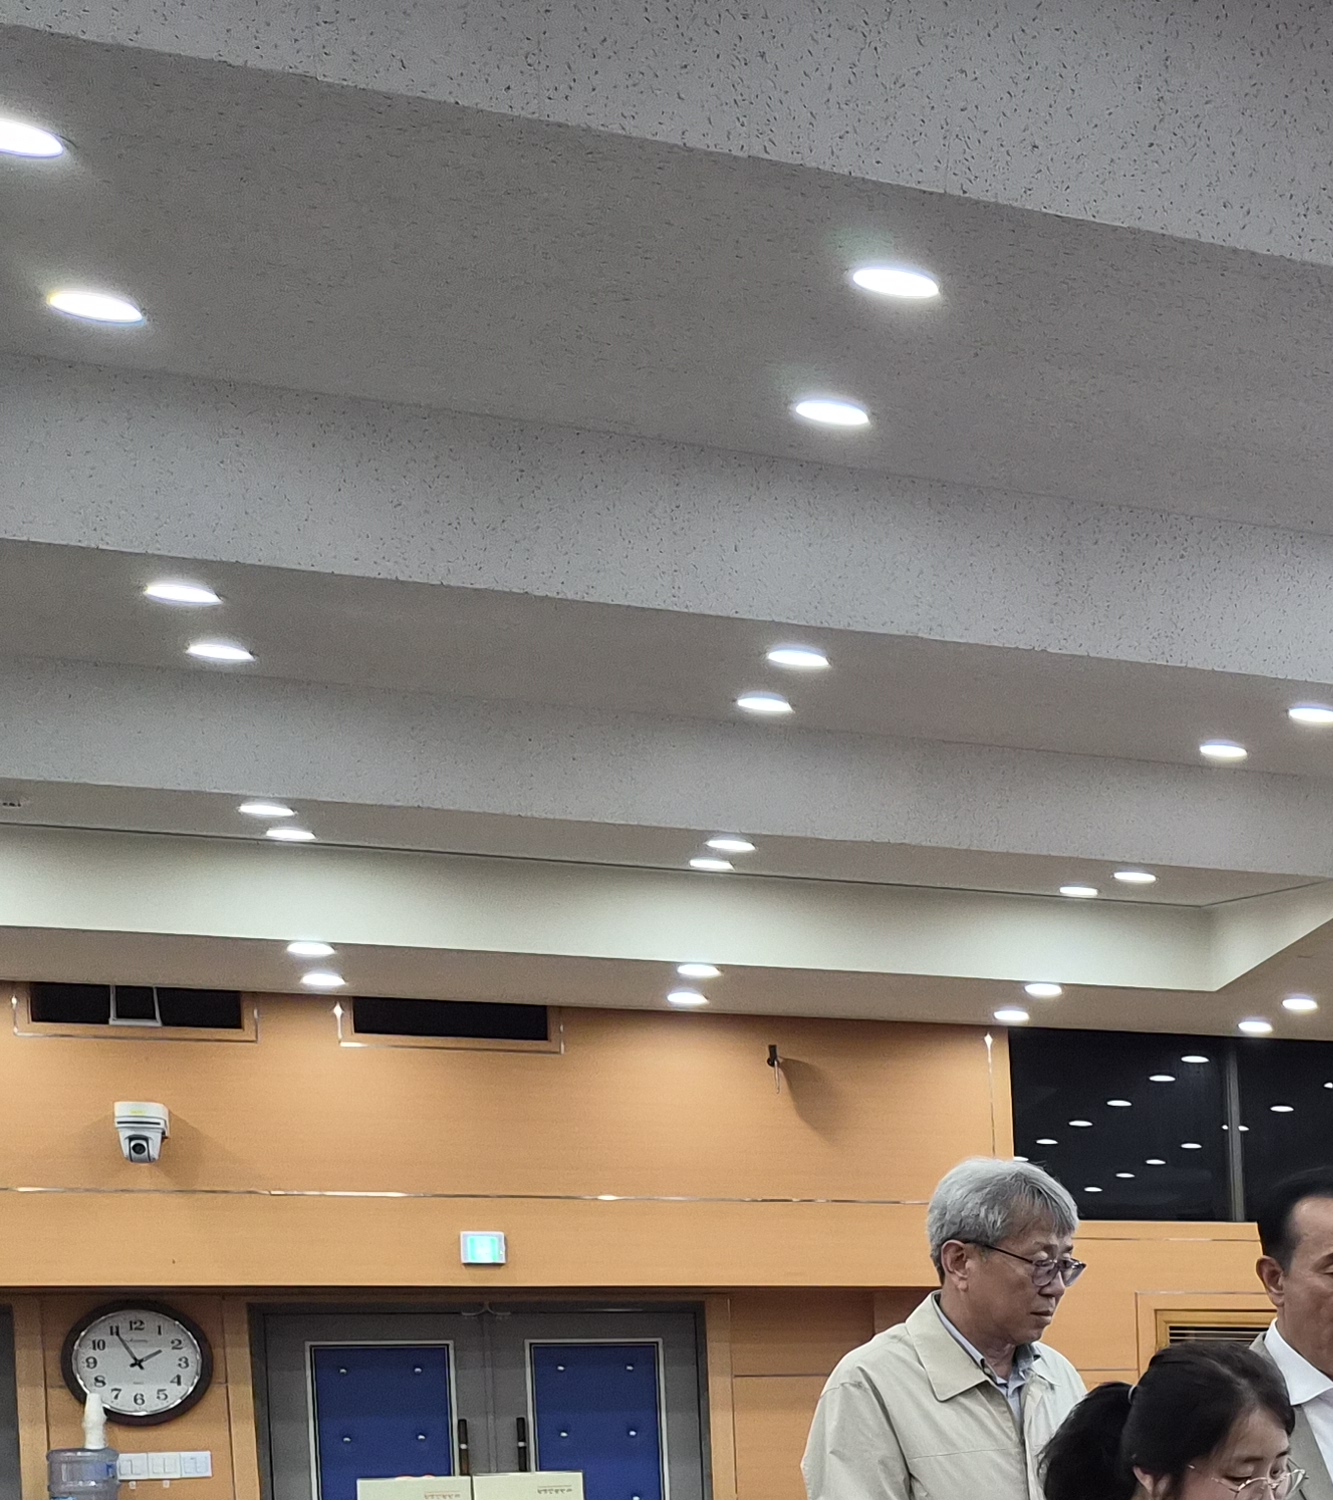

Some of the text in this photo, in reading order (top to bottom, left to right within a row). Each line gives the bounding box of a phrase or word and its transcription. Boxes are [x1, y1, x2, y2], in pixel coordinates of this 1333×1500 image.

[129, 1320, 145, 1331] 12
[157, 1325, 162, 1336] 1
[92, 1339, 106, 1351] 10
[170, 1339, 183, 1350] 2
[85, 1356, 97, 1369] 9
[178, 1356, 189, 1369] 3
[94, 1375, 106, 1387] 8
[170, 1374, 182, 1386] 4
[111, 1388, 122, 1400] 7
[133, 1393, 145, 1405] 6
[156, 1389, 168, 1401] 5
